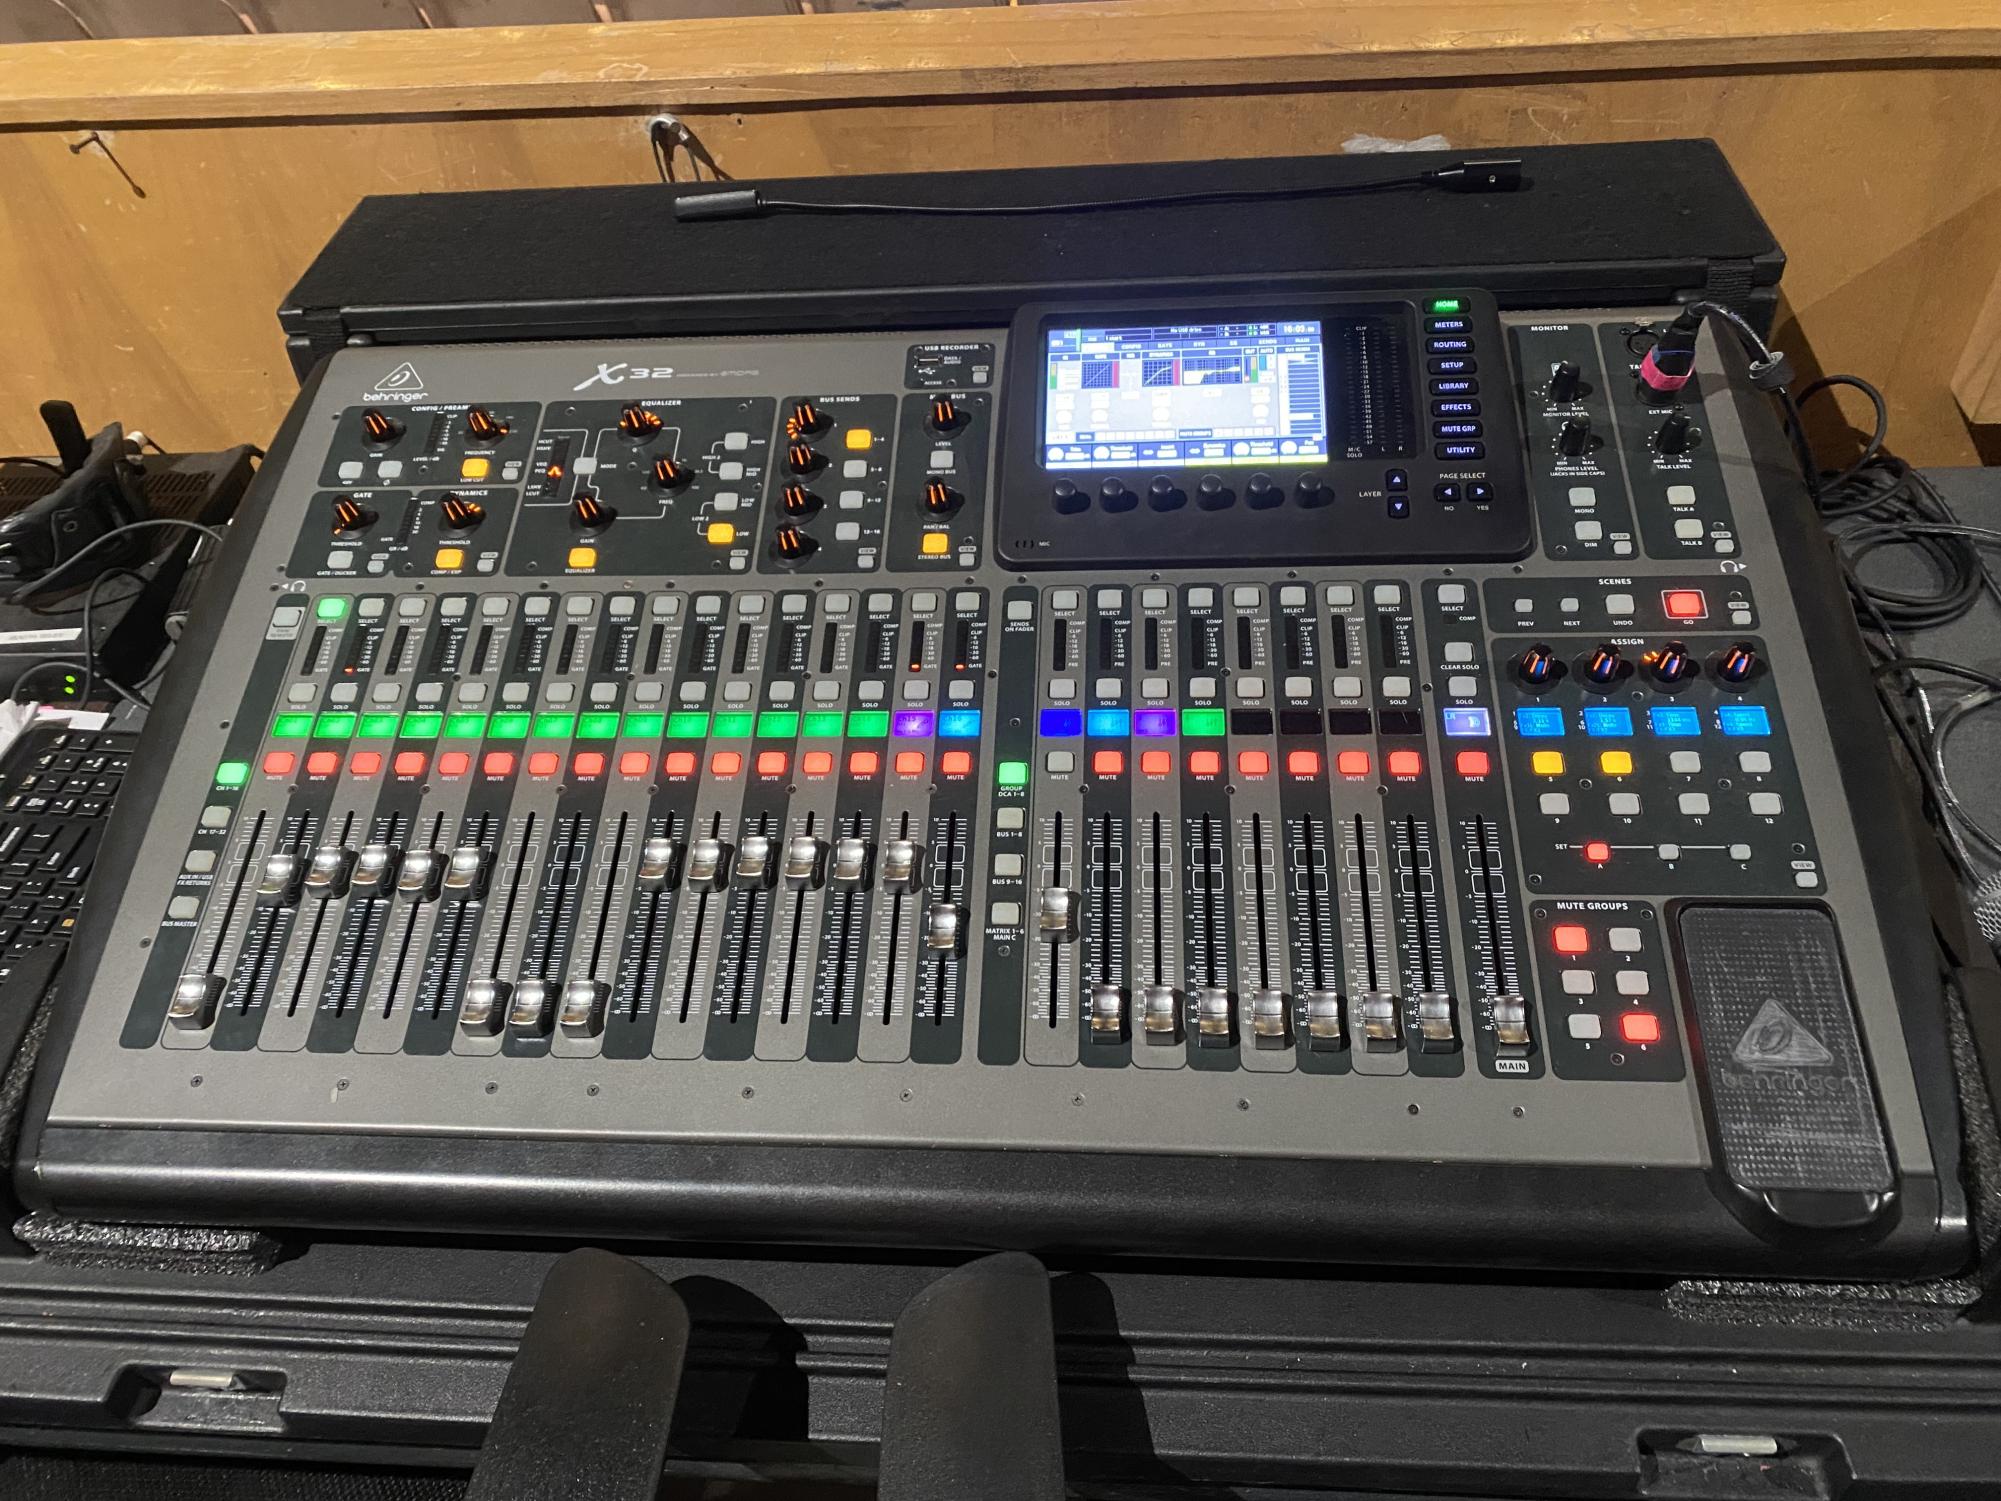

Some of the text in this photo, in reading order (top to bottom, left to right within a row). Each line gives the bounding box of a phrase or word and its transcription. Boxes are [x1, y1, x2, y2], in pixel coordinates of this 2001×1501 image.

[1435, 300, 1459, 308] HOME
[1433, 341, 1467, 349] ROUTING
[1440, 361, 1464, 369] SETUP
[1438, 382, 1469, 390] LIBRARY
[362, 391, 429, 402] behringer
[1440, 403, 1472, 411] EFFECTS
[1441, 424, 1476, 433] MUTE GRP
[1446, 446, 1476, 454] UTILITY
[1598, 578, 1632, 586] SCENES
[1612, 619, 1634, 627] UNDO
[1610, 638, 1644, 646] ASSIGN
[1556, 901, 1629, 911] MUTE GROUPS
[1498, 1061, 1527, 1071] MAIN
